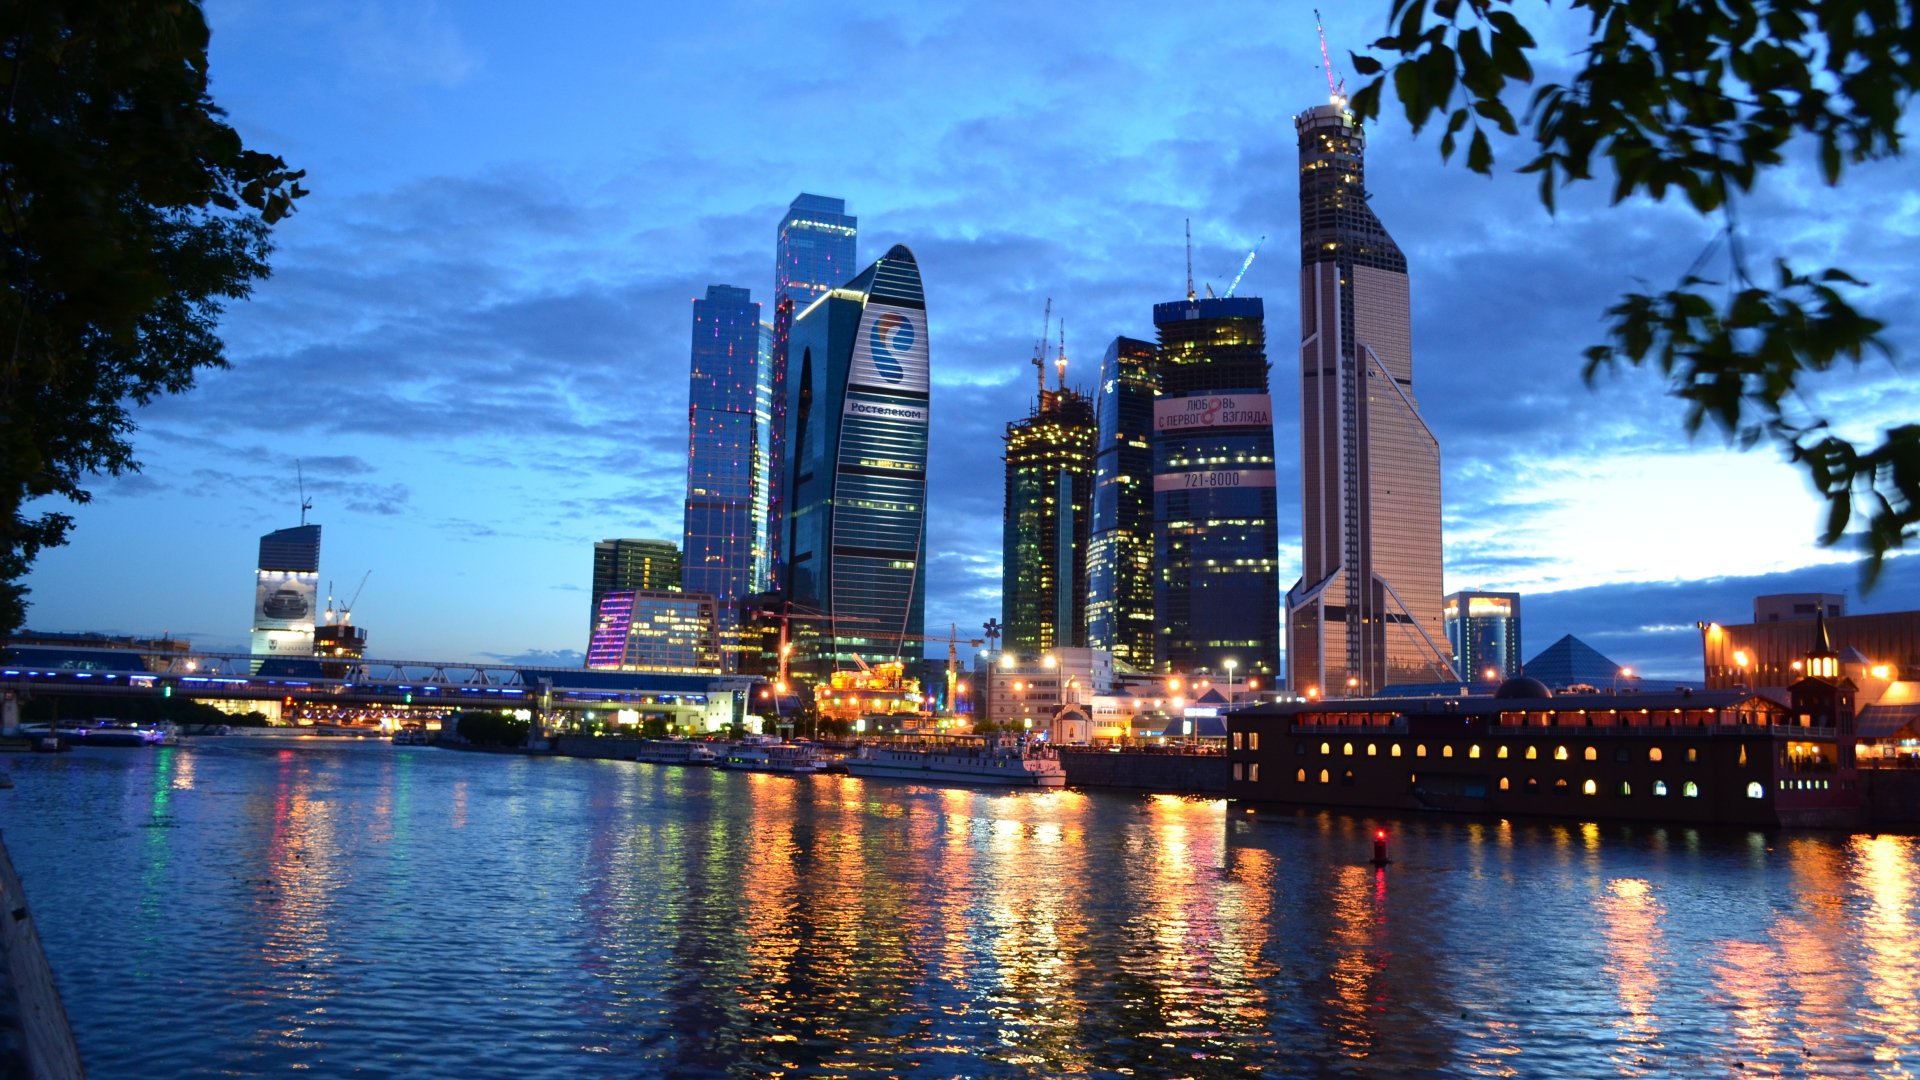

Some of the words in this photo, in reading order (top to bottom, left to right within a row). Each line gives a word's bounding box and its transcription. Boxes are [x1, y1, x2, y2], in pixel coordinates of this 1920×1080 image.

[851, 402, 921, 418] Ростелеком
[1159, 416, 1164, 427] С
[1223, 411, 1268, 424] ВЗГЛЯДА
[1185, 472, 1239, 487] 721-8000
